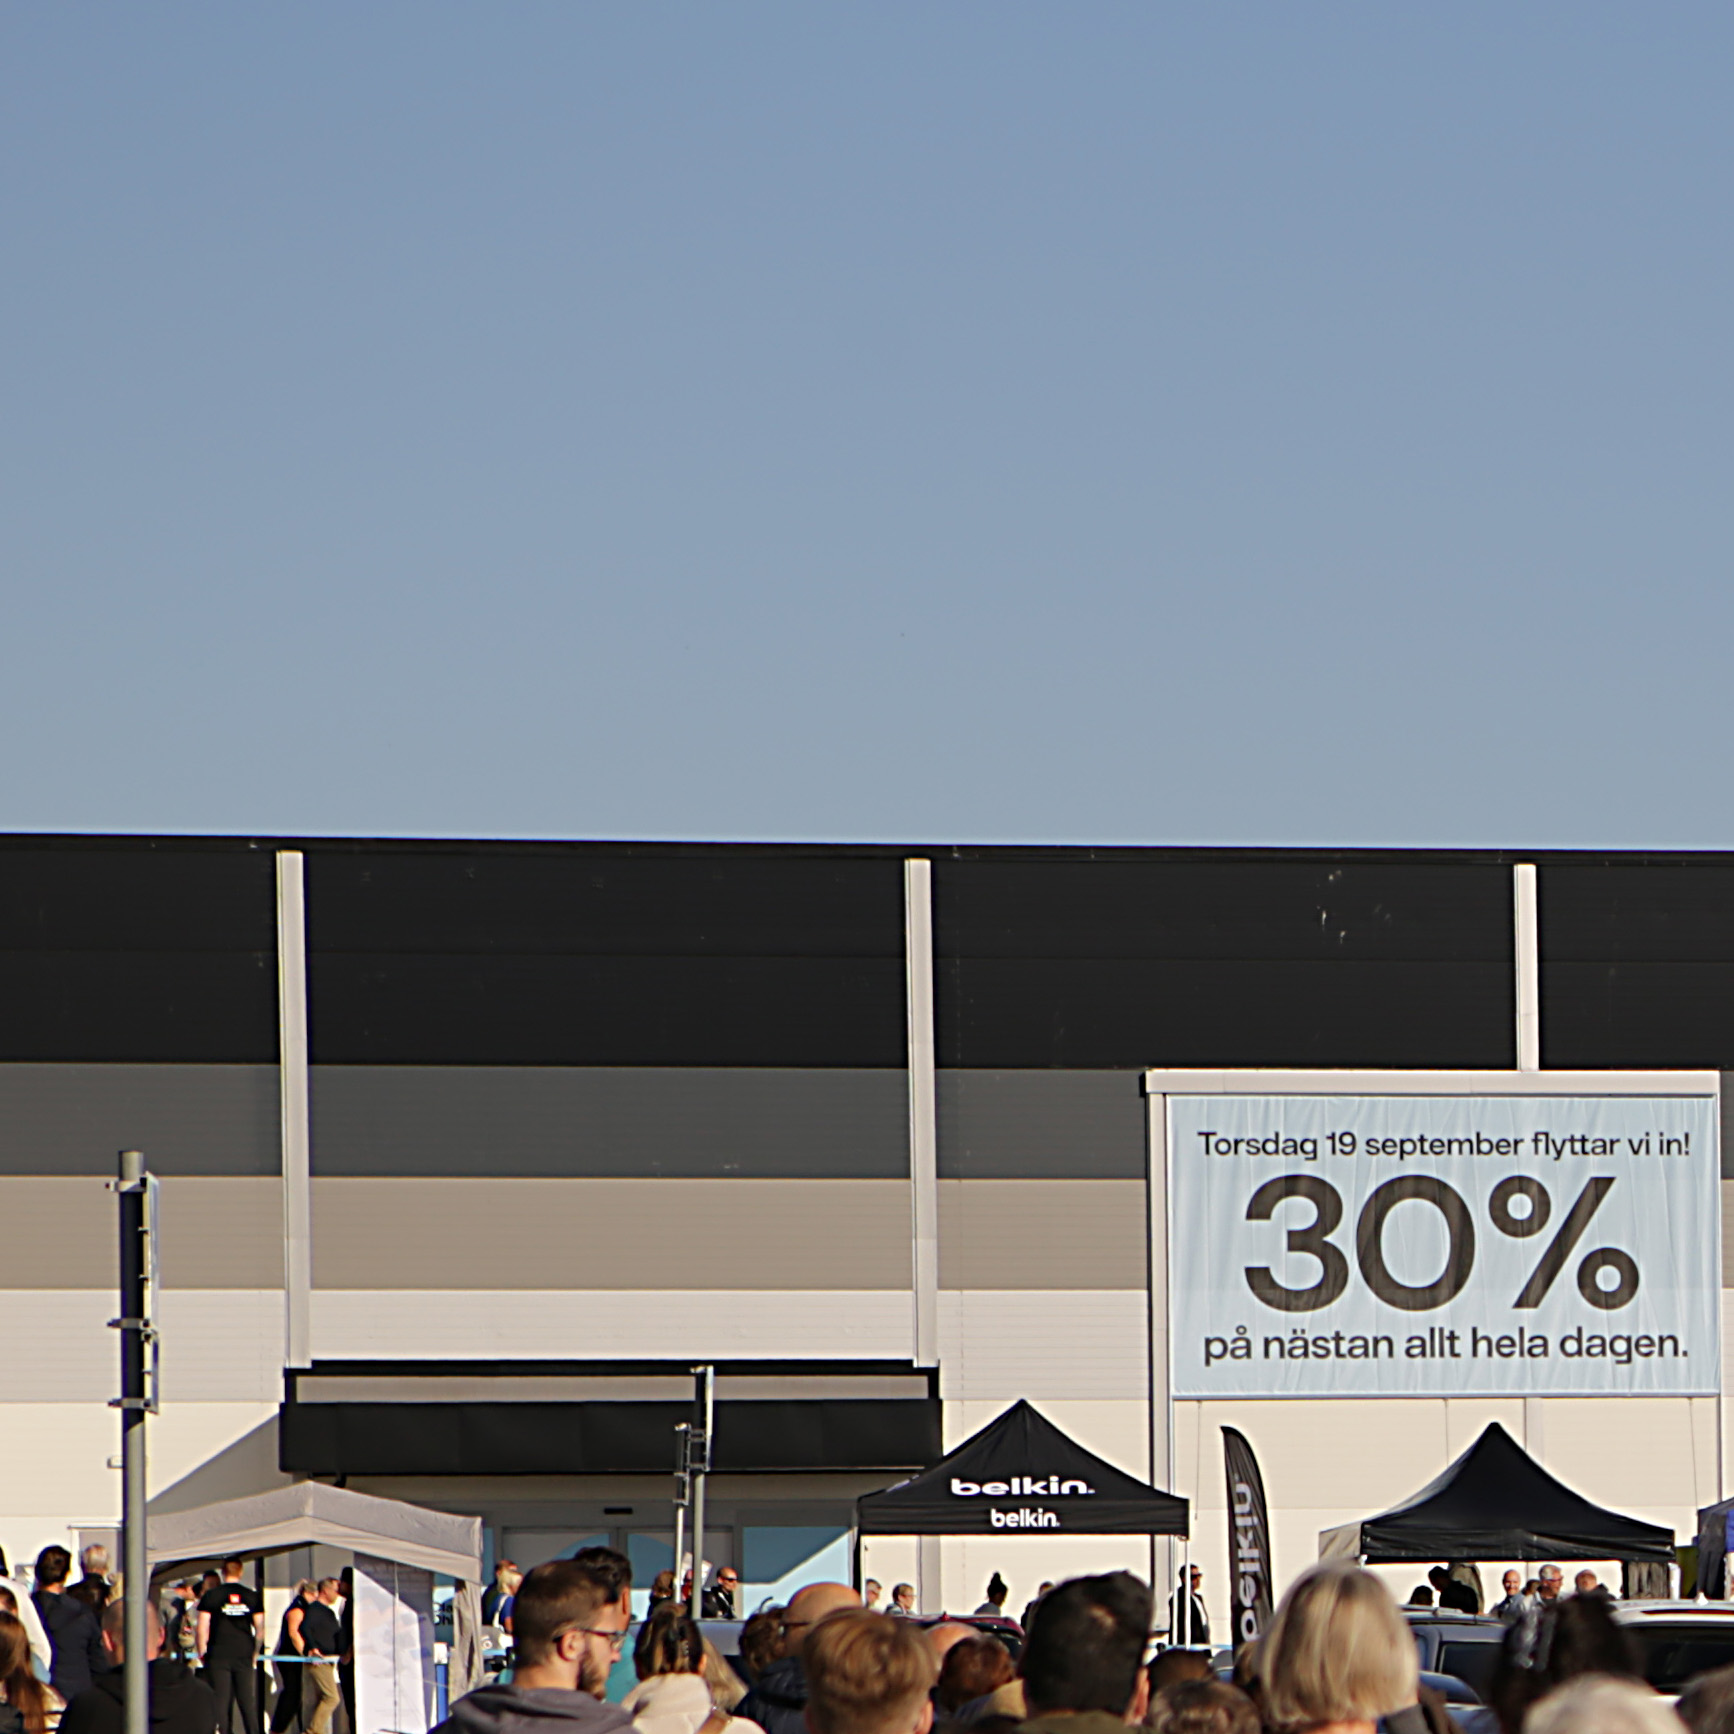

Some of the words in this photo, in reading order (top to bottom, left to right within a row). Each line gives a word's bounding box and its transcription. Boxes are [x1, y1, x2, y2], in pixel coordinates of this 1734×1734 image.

[1197, 1131, 1318, 1161] Torsdag
[1326, 1132, 1356, 1155] 19
[1365, 1131, 1524, 1162] september
[1531, 1131, 1621, 1162] flyttar
[1628, 1132, 1651, 1156] vi
[1658, 1132, 1691, 1156] in!
[1244, 1174, 1641, 1313] 30%
[1204, 1325, 1252, 1366] på
[1263, 1328, 1394, 1359] nästan
[1405, 1326, 1461, 1359] allt
[1471, 1326, 1549, 1359] hela
[1560, 1326, 1689, 1365] dagen.
